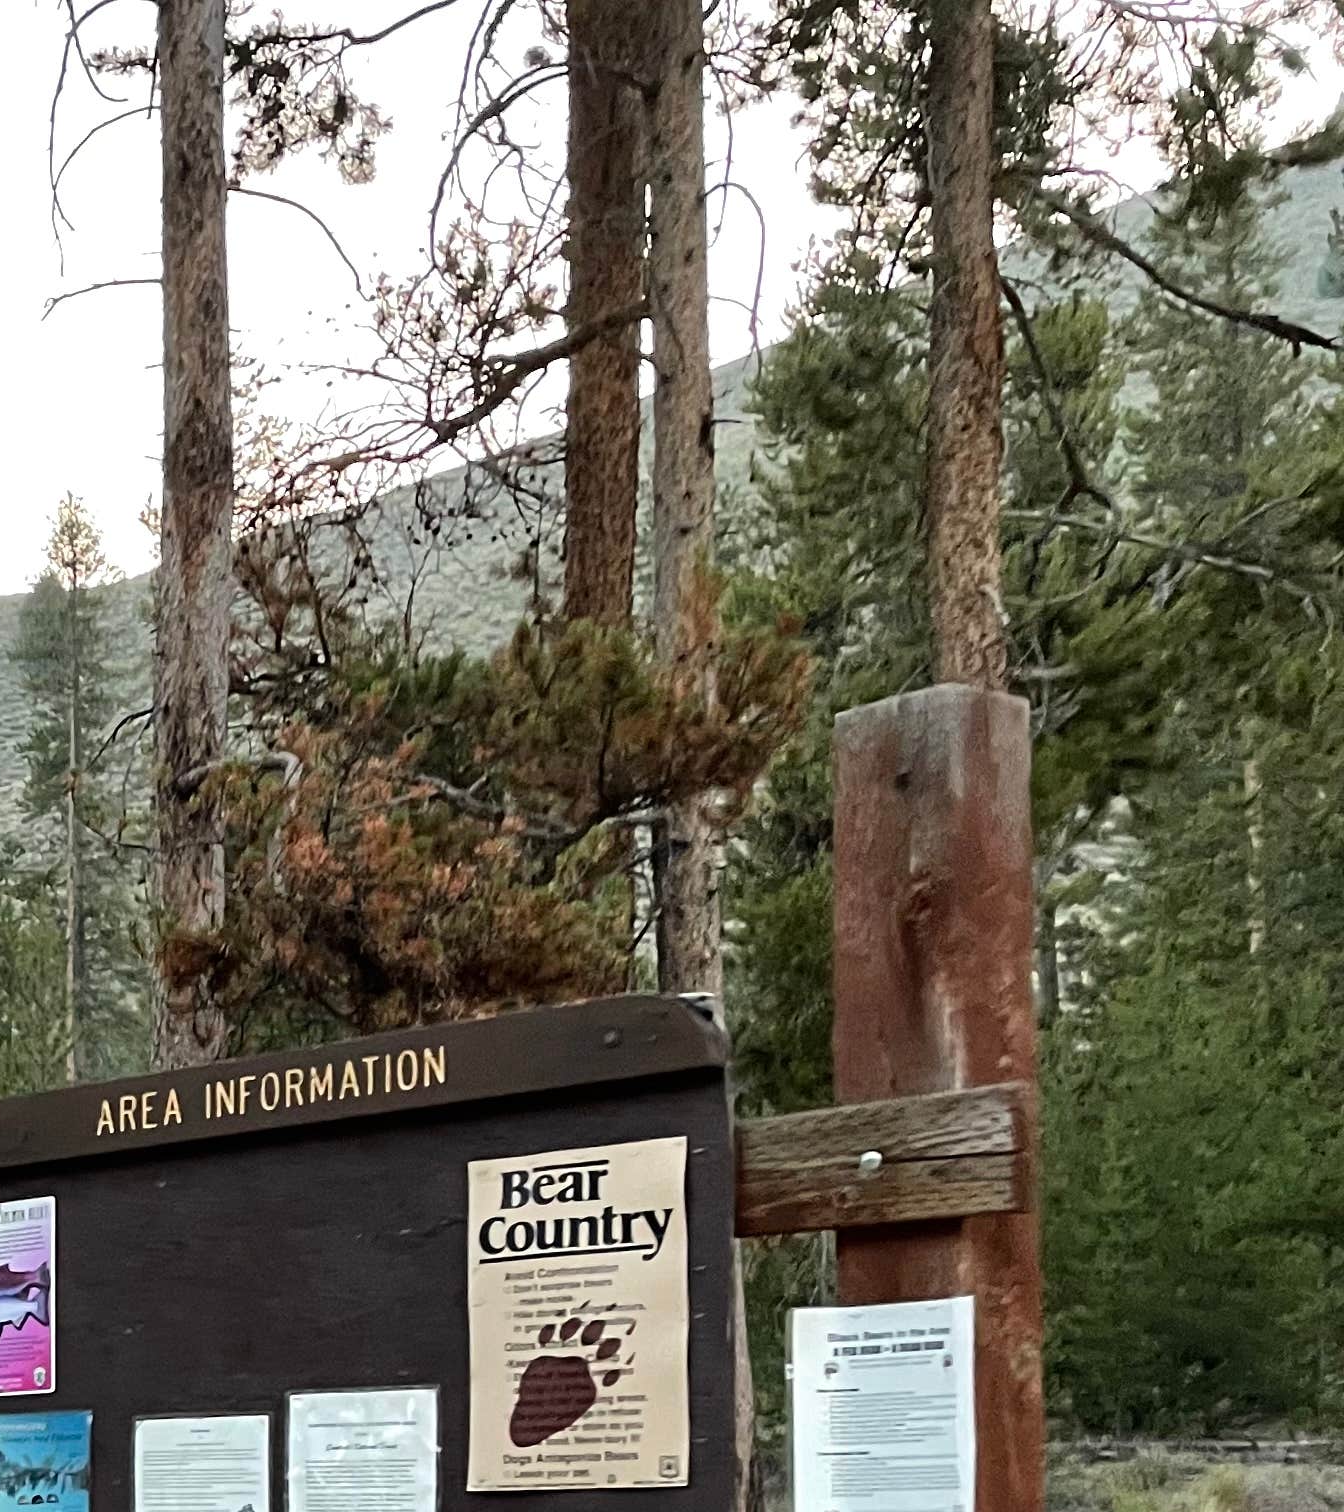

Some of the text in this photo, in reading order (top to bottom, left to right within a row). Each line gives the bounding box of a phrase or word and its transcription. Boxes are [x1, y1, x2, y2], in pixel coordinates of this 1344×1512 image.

[96, 1045, 446, 1136] AREA INFORMATION
[500, 1168, 608, 1210] Bear
[479, 1206, 674, 1261] Country
[503, 1454, 532, 1466] Dogs
